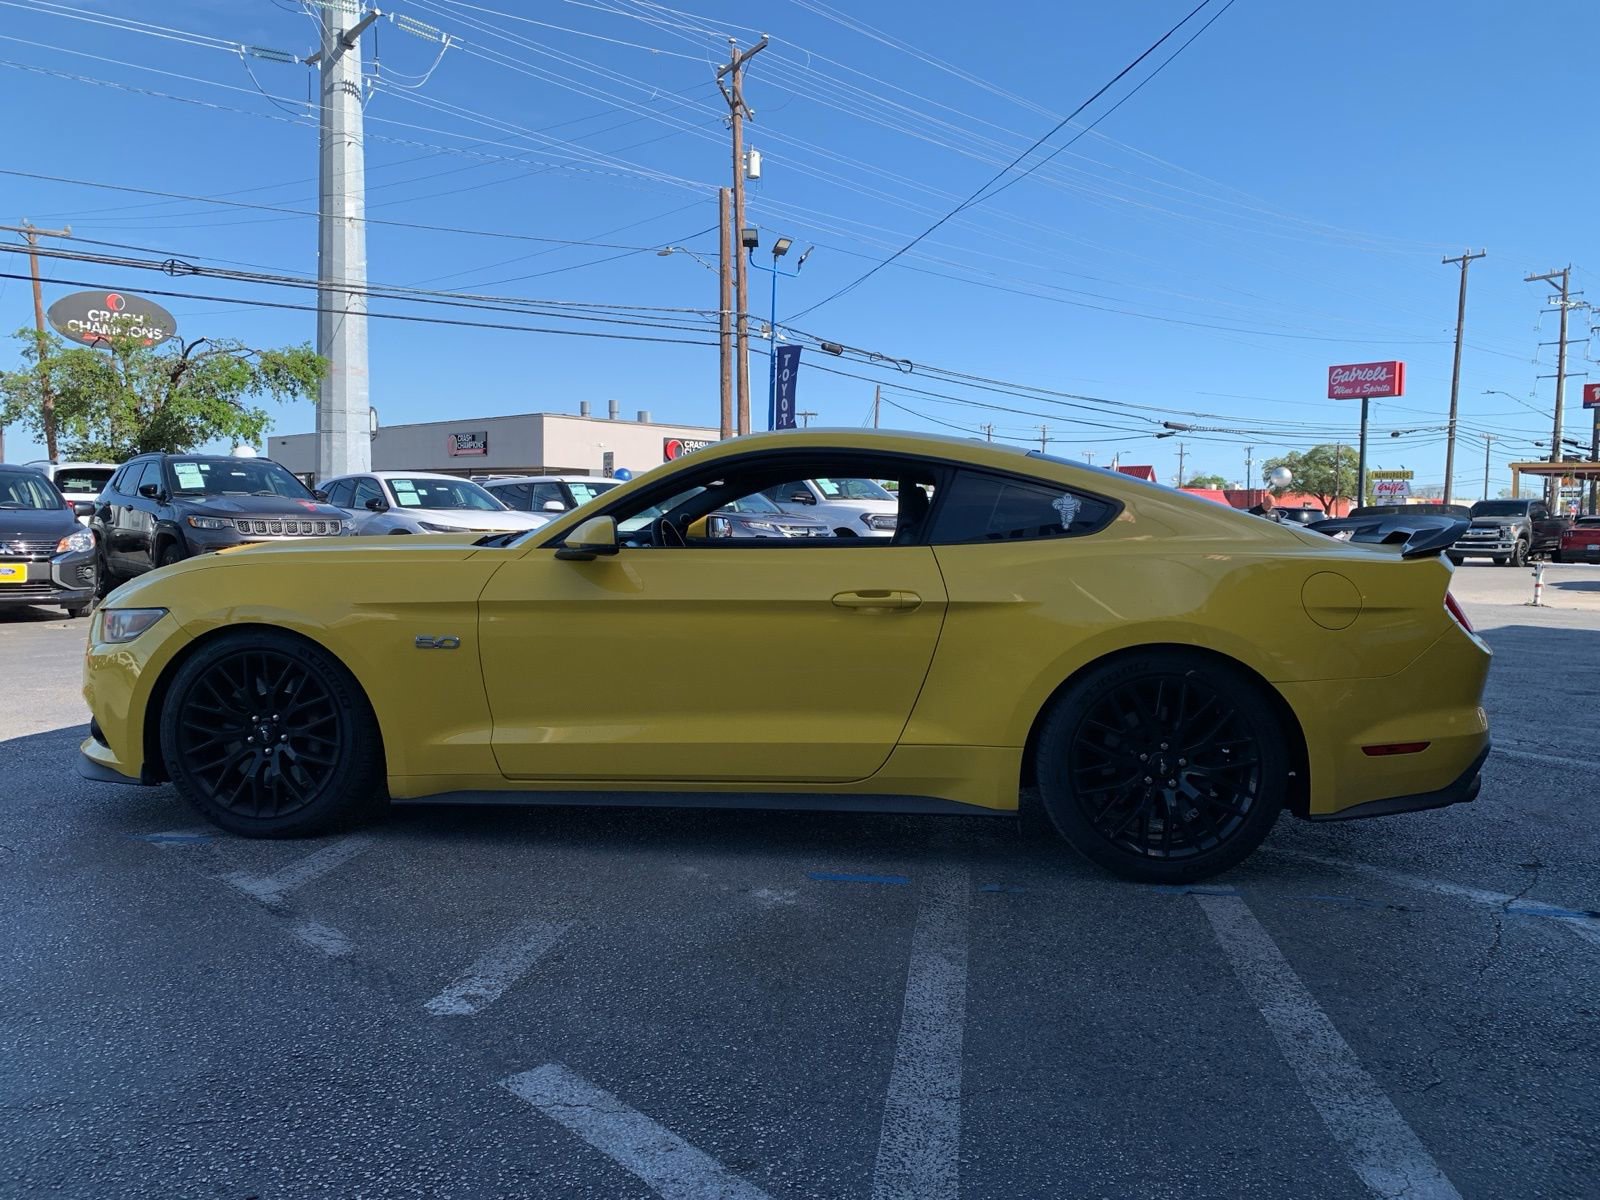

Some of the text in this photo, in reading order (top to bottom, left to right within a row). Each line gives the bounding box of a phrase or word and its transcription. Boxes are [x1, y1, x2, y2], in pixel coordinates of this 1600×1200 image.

[1330, 366, 1394, 385] Gabriels
[1362, 383, 1390, 394] Spirits
[604, 467, 613, 478] 35
